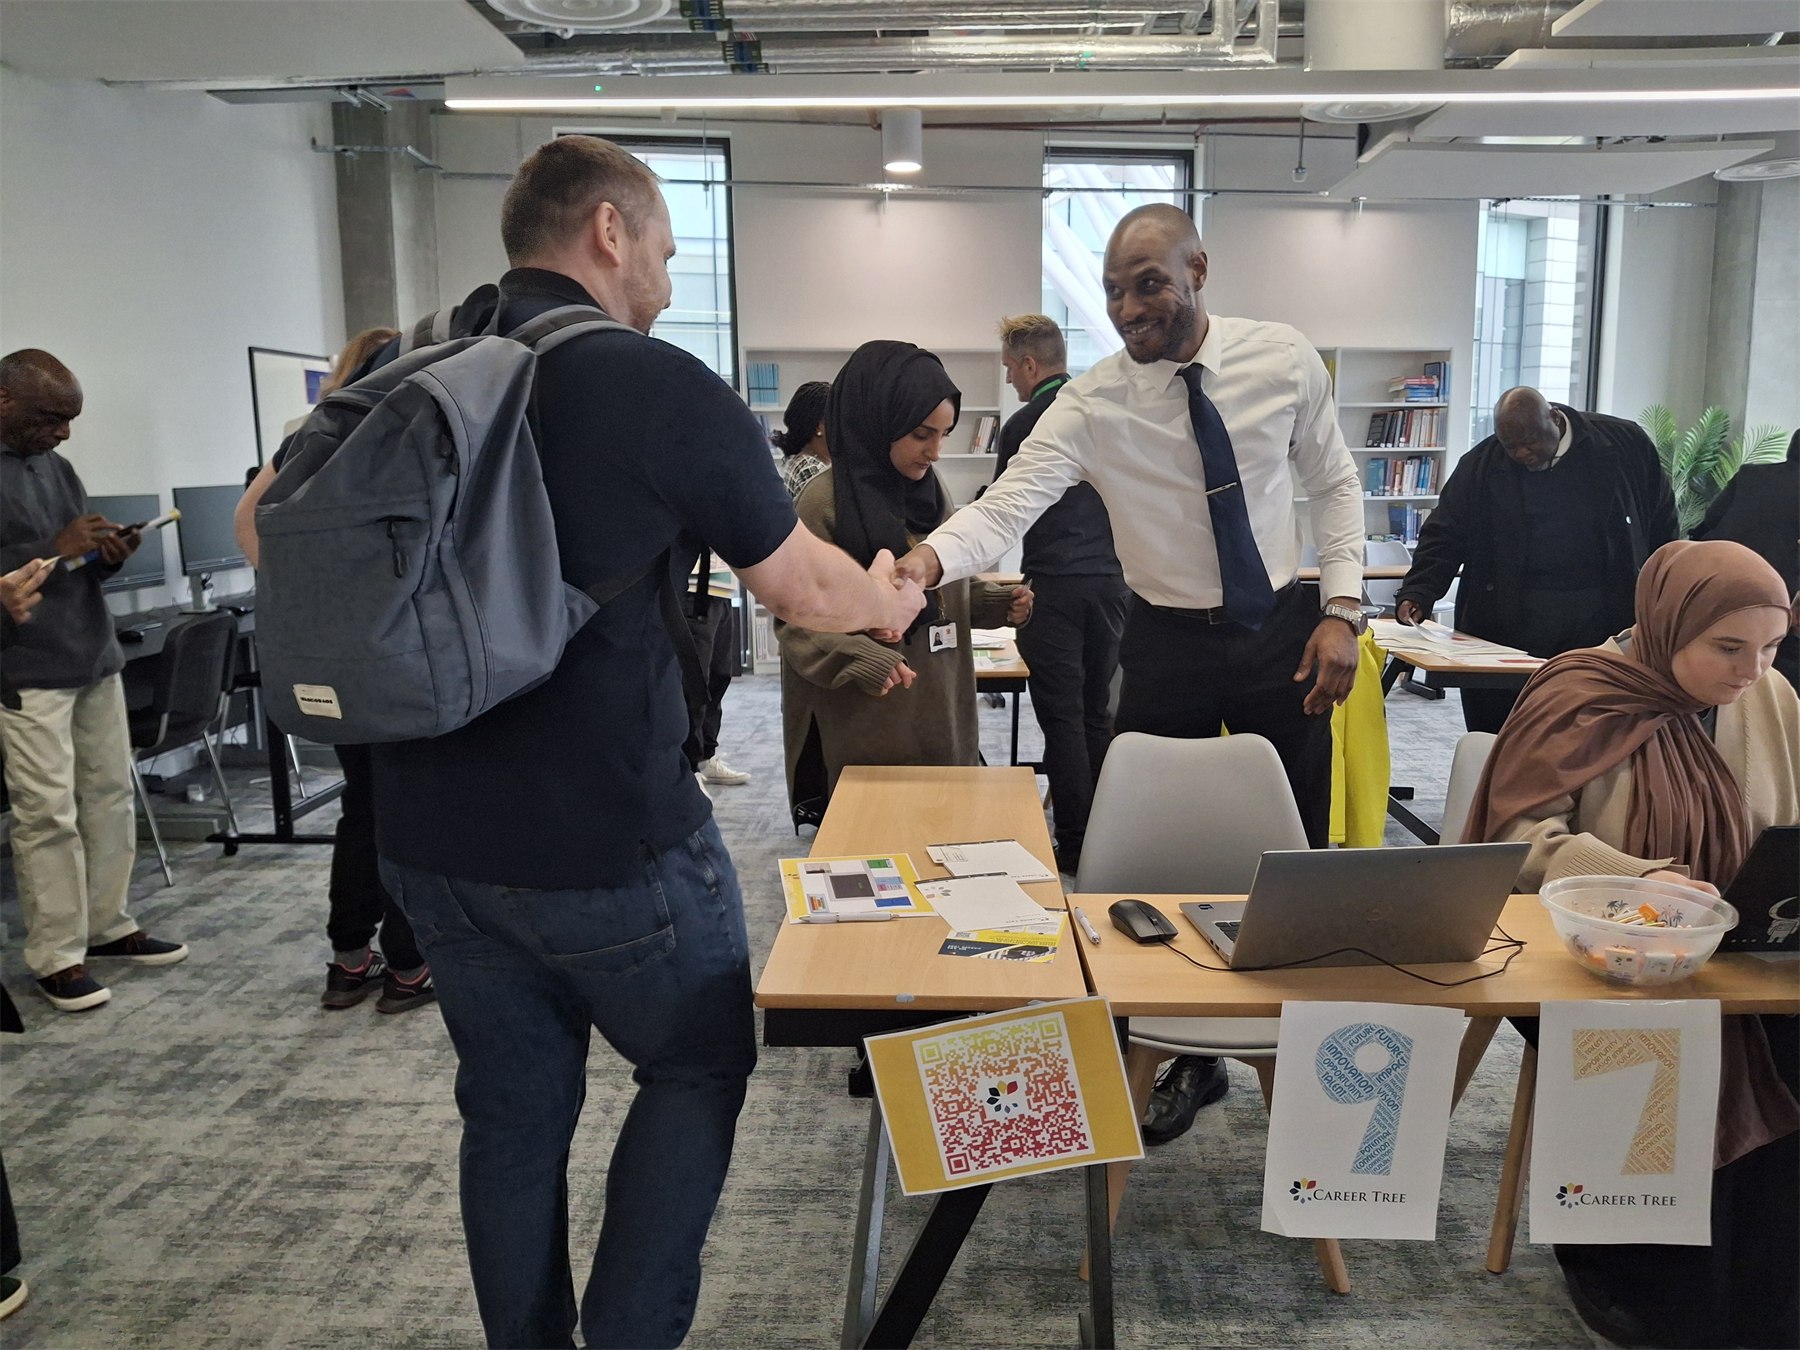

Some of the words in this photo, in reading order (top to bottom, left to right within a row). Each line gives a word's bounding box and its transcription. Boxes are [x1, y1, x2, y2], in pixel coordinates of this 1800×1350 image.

[1348, 1025, 1376, 1047] FUTURE
[1374, 1028, 1404, 1058] FUTURE
[1611, 1037, 1634, 1059] IMPACT
[1579, 1038, 1619, 1077] OPPORTUNITY
[1639, 1033, 1675, 1071] INNOVATION
[1322, 1057, 1364, 1100] OPPORTUNITY
[1325, 1043, 1375, 1094] INNOVATION
[1375, 1055, 1408, 1084] IMPACT
[1320, 1070, 1348, 1097] TALENT
[1315, 1021, 1414, 1177] 9
[1377, 1087, 1400, 1112] VISION
[1573, 1027, 1682, 1176] 7
[1646, 1102, 1668, 1123] VISION
[1359, 1129, 1392, 1156] POTENTIAL
[1633, 1122, 1665, 1148] POTENTIAL
[1636, 1126, 1671, 1158] CONNECTION
[1355, 1141, 1391, 1170] CONNECTION
[1313, 1188, 1368, 1202] CAREER
[1372, 1190, 1407, 1204] TREE
[1580, 1193, 1636, 1206] CAREER
[1641, 1194, 1677, 1207] TREE
